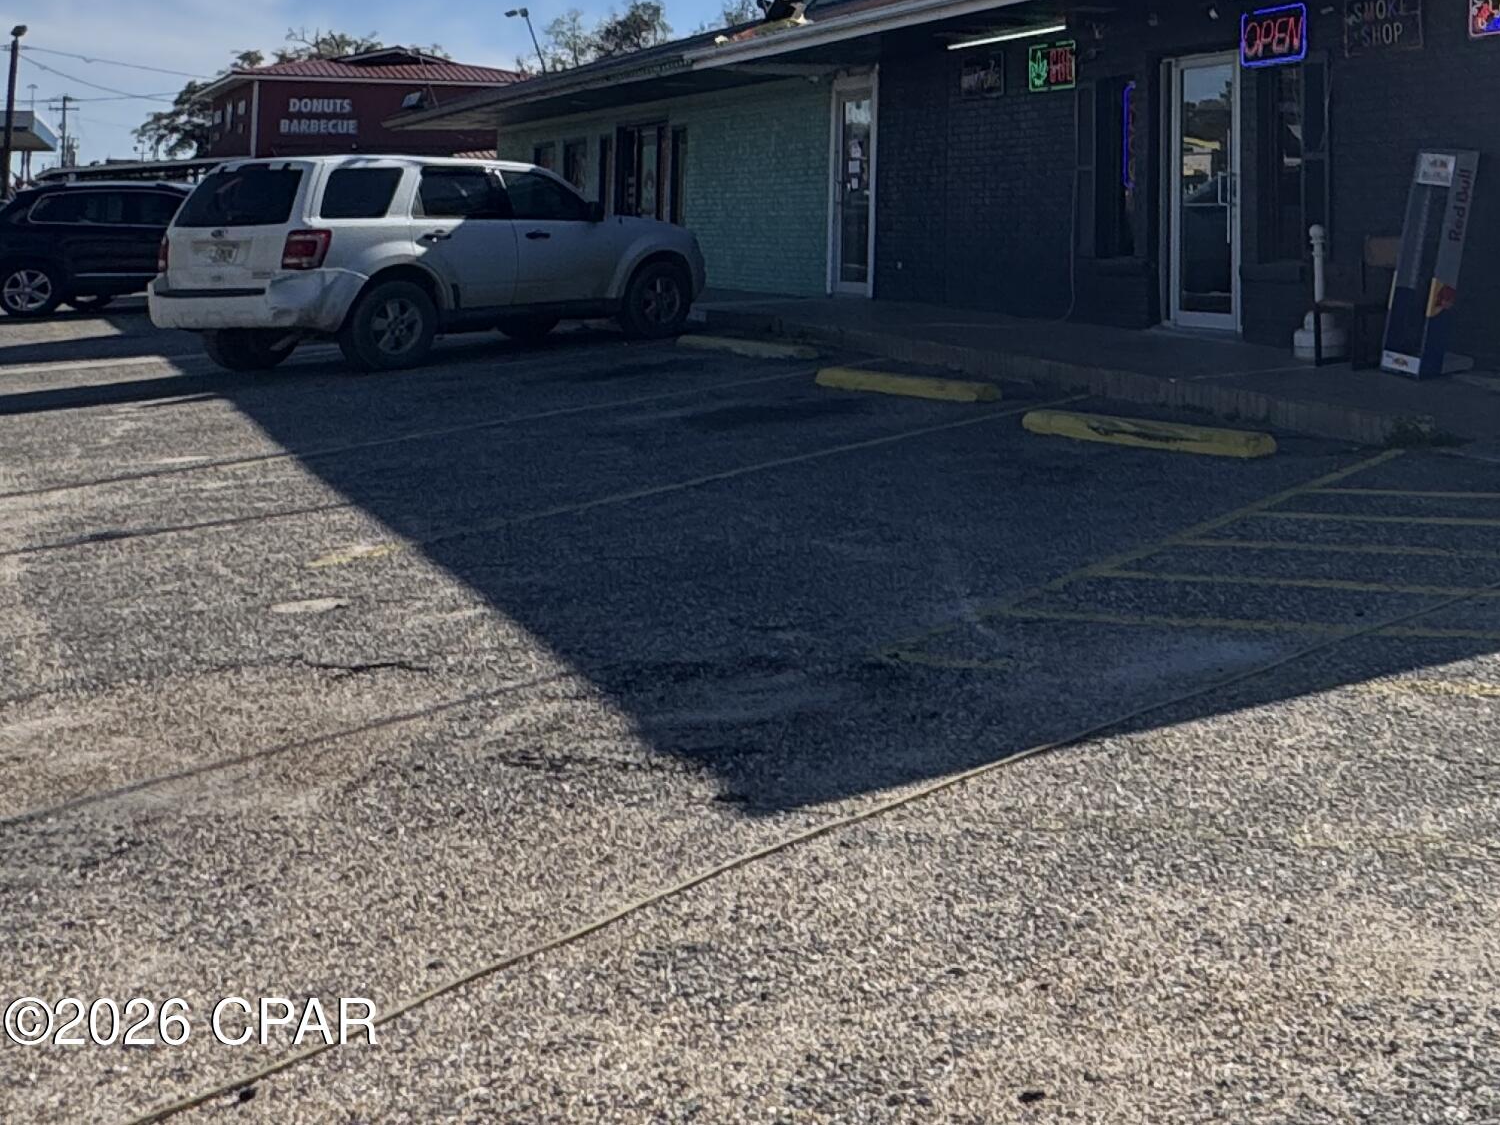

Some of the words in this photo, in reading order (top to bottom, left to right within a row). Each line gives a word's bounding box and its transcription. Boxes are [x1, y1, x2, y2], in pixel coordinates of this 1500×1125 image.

[1244, 15, 1302, 58] OPEN
[1362, 21, 1403, 47] SHOP
[288, 98, 353, 114] DONUTS
[280, 118, 358, 134] BARBECUE
